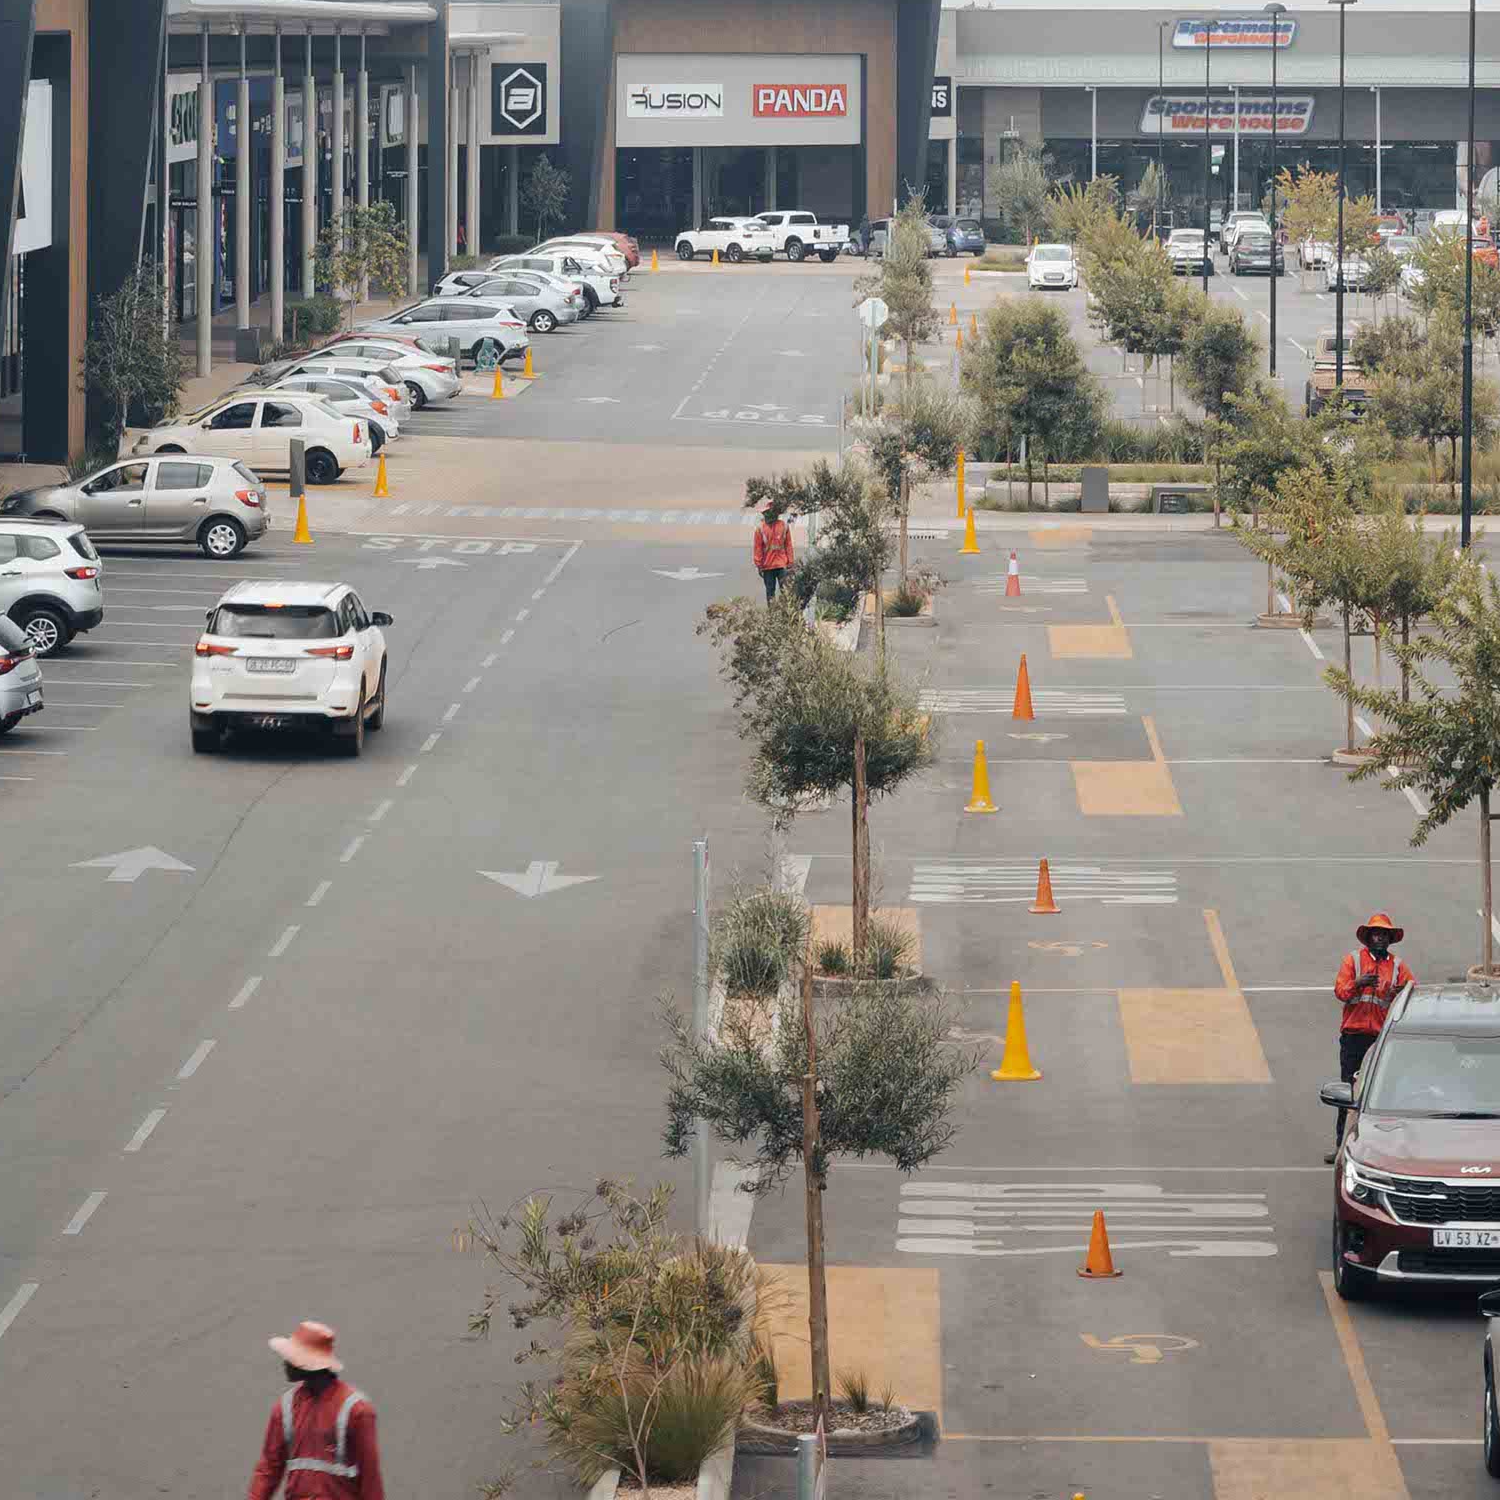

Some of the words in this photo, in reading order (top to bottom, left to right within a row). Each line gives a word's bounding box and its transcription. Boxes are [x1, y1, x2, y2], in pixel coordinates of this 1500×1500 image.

[758, 89, 844, 112] PANDA
[1149, 99, 1308, 116] Sportsmans
[1172, 115, 1305, 130] Warehouse
[361, 537, 539, 555] STOP
[1437, 1232, 1451, 1245] LV
[1457, 1232, 1470, 1245] 53
[1477, 1233, 1491, 1245] XZ
